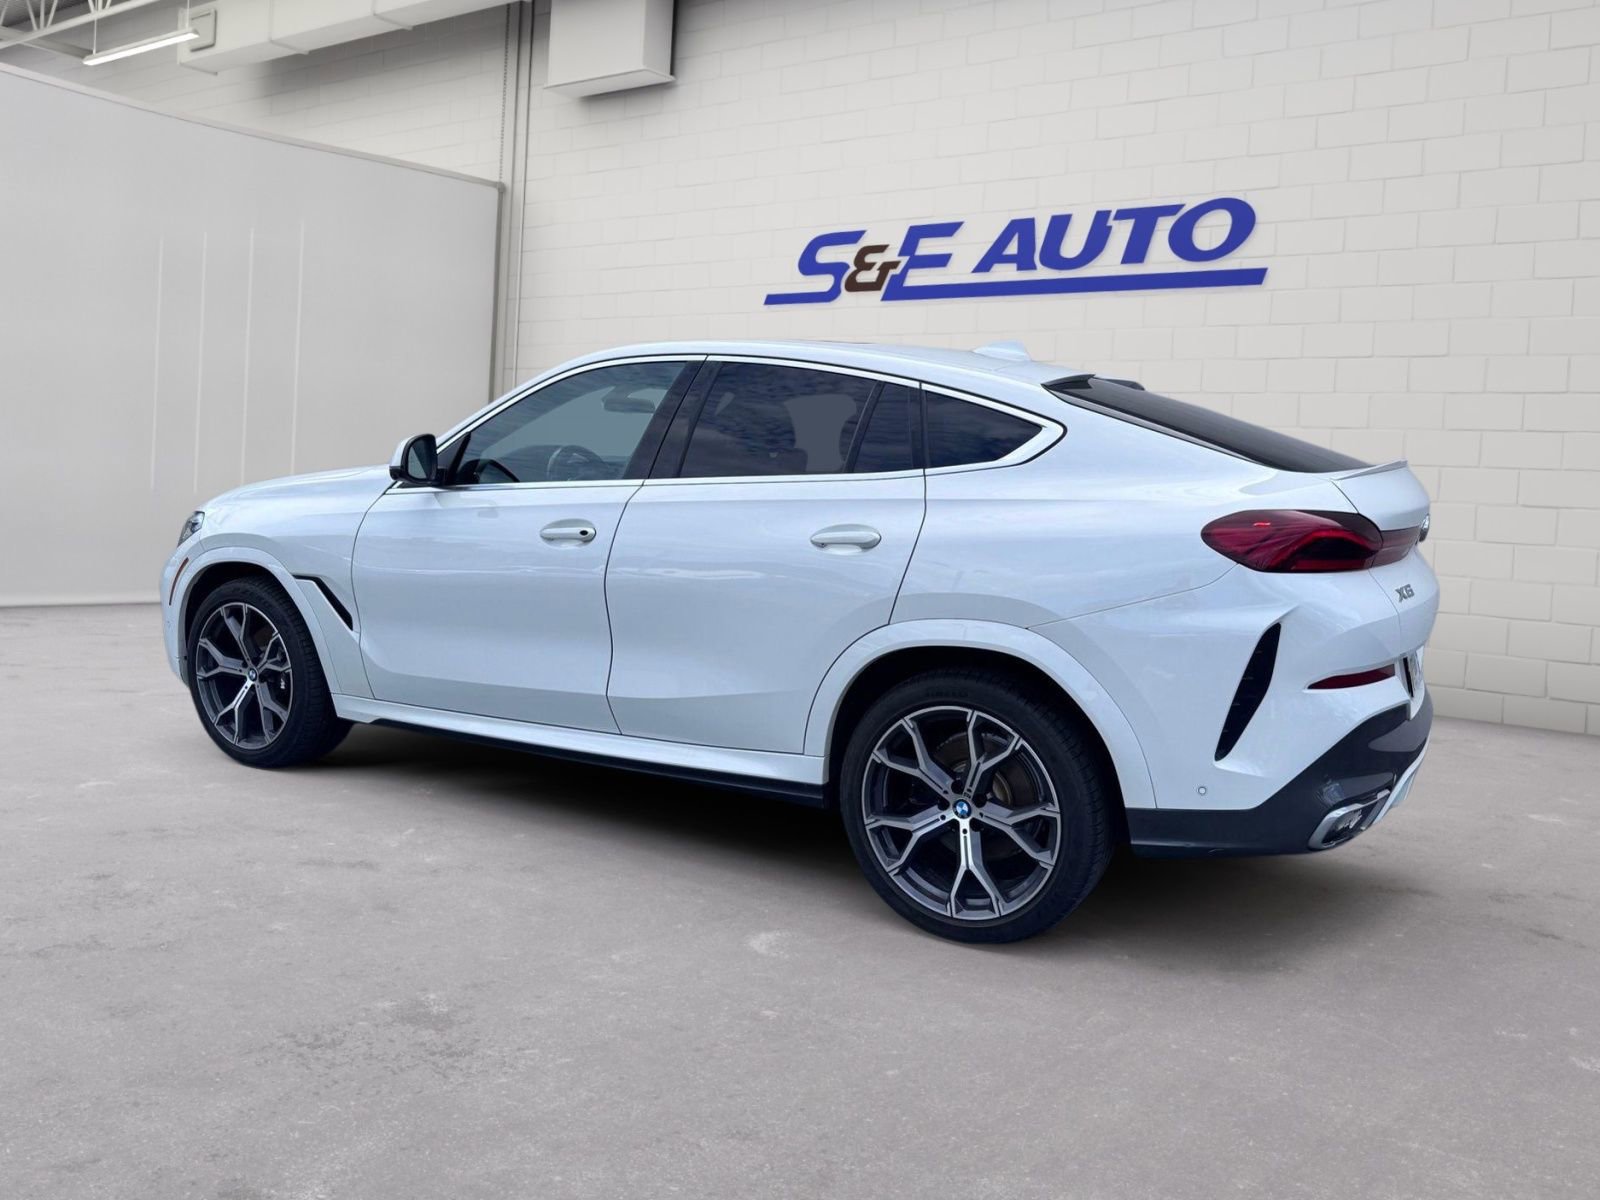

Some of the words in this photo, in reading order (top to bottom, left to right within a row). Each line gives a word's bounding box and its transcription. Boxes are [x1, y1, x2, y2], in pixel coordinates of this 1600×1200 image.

[765, 222, 965, 304] S&E
[972, 197, 1256, 274] AUTO
[1395, 584, 1415, 602] X6
